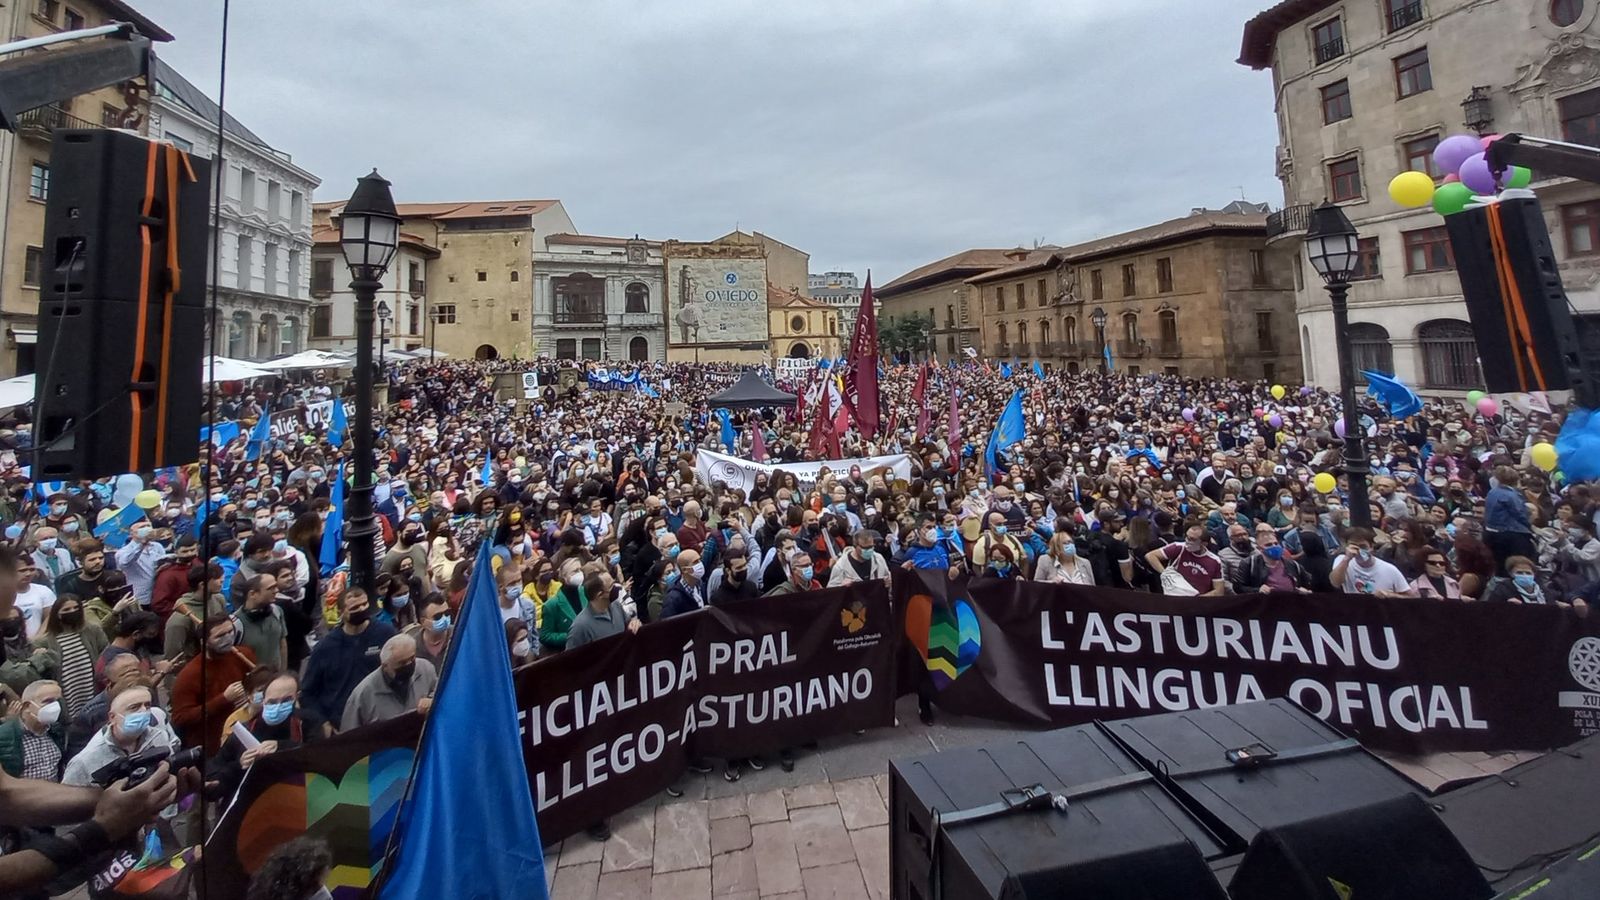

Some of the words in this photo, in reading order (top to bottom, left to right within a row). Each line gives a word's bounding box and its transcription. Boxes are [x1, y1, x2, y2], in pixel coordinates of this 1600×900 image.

[705, 290, 758, 302] OVIEDO
[708, 630, 797, 675] PRAL
[1041, 610, 1400, 670] L'ASTURIANU
[1044, 663, 1267, 711] LLINGUA
